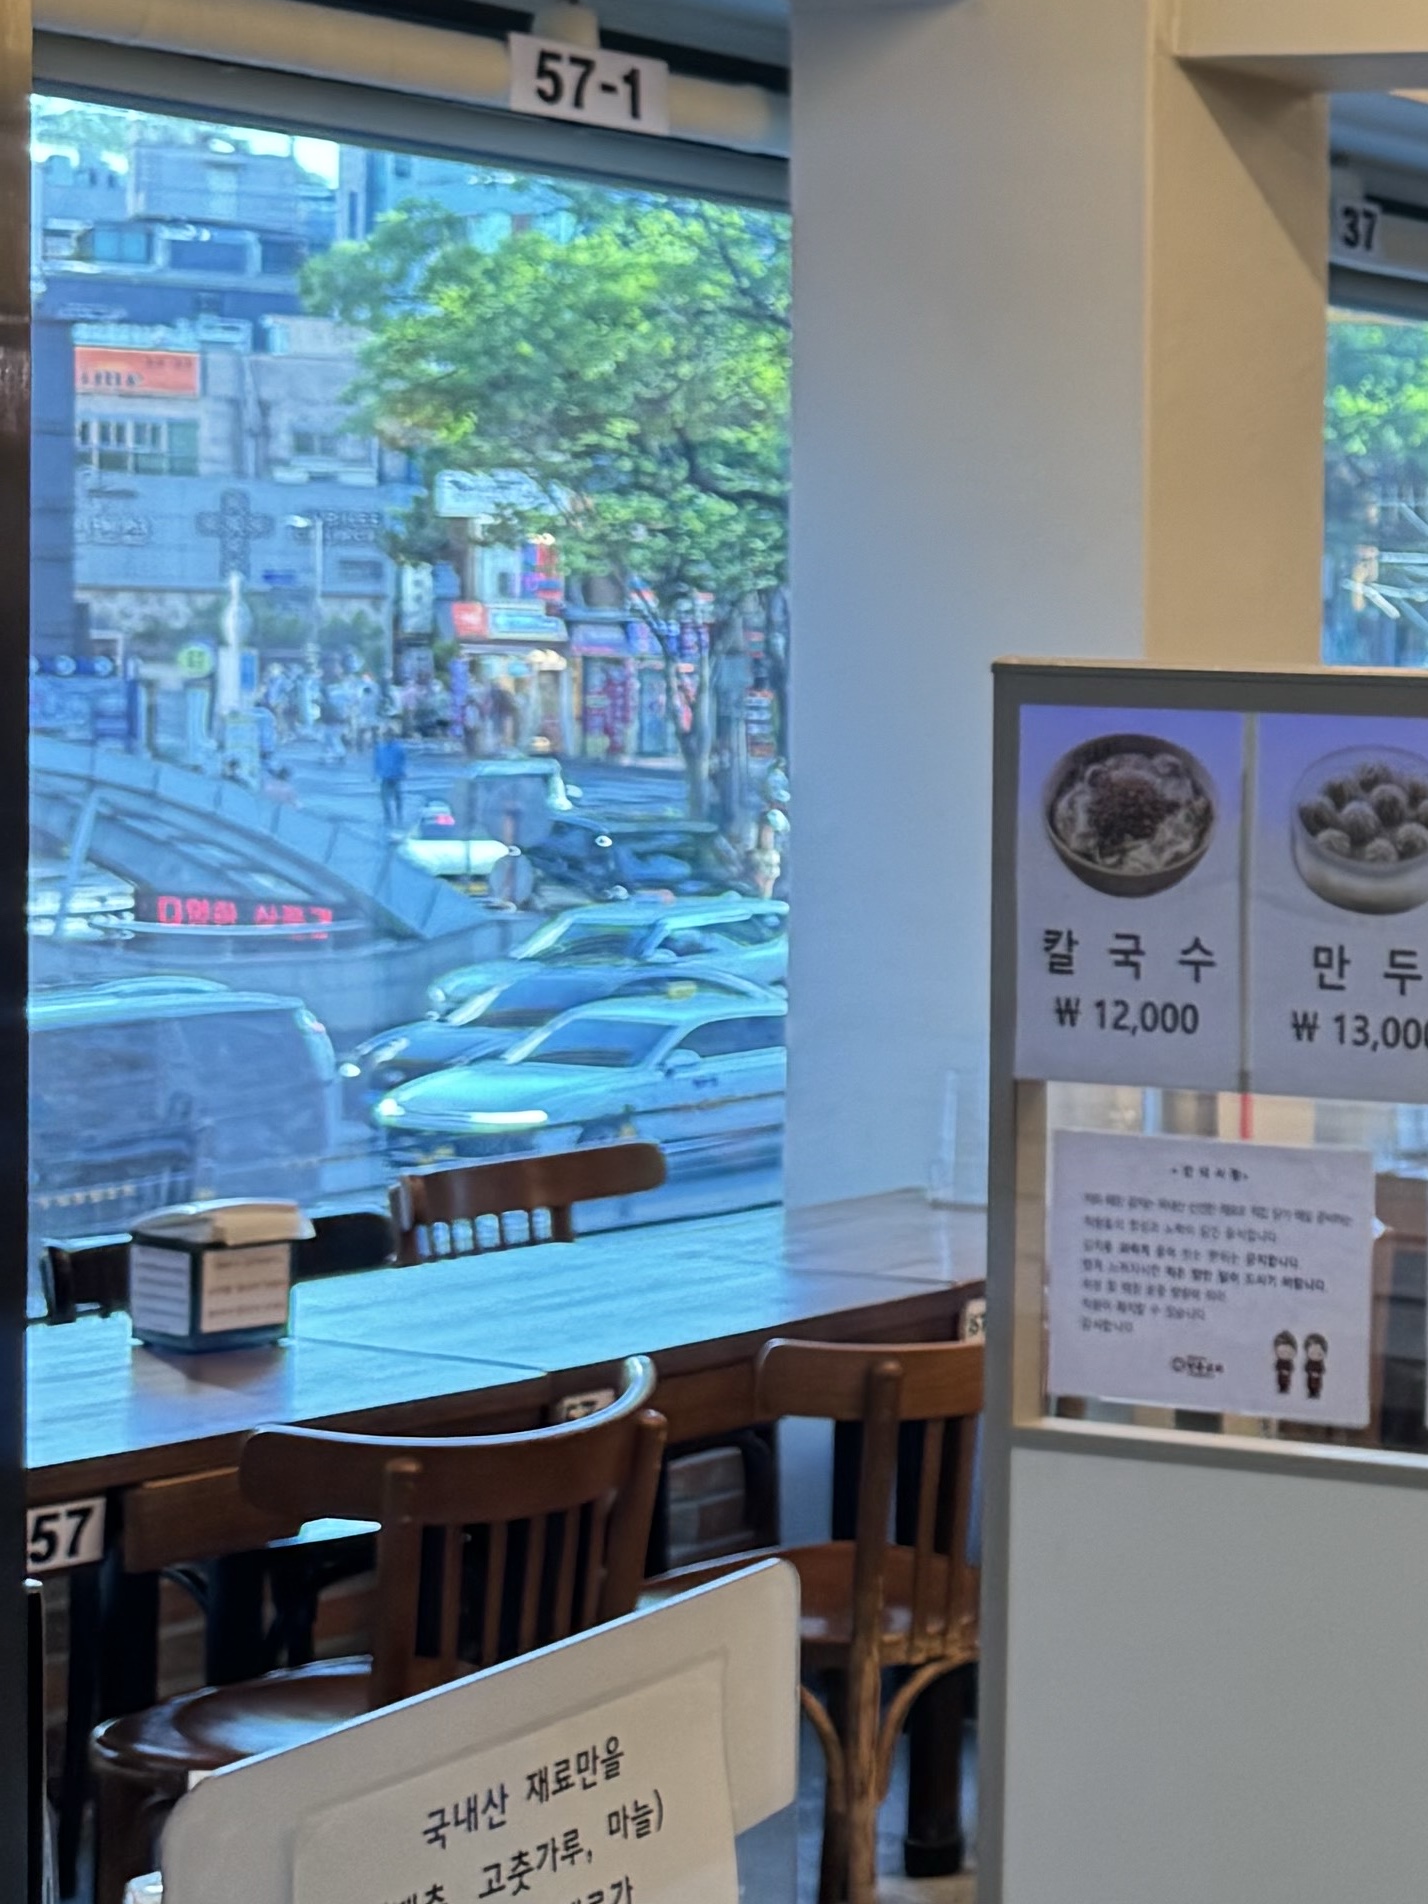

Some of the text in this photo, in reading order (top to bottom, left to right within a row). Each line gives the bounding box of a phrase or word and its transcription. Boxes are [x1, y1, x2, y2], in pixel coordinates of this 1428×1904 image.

[536, 48, 641, 119] 57-1
[1342, 206, 1378, 251] 37
[1095, 999, 1199, 1036] 12,000
[29, 1505, 95, 1564] 57
[422, 1736, 625, 1849] 국내산 재료만을
[478, 1829, 592, 1898] 고춧가루,
[607, 1789, 664, 1840] 마늘)
